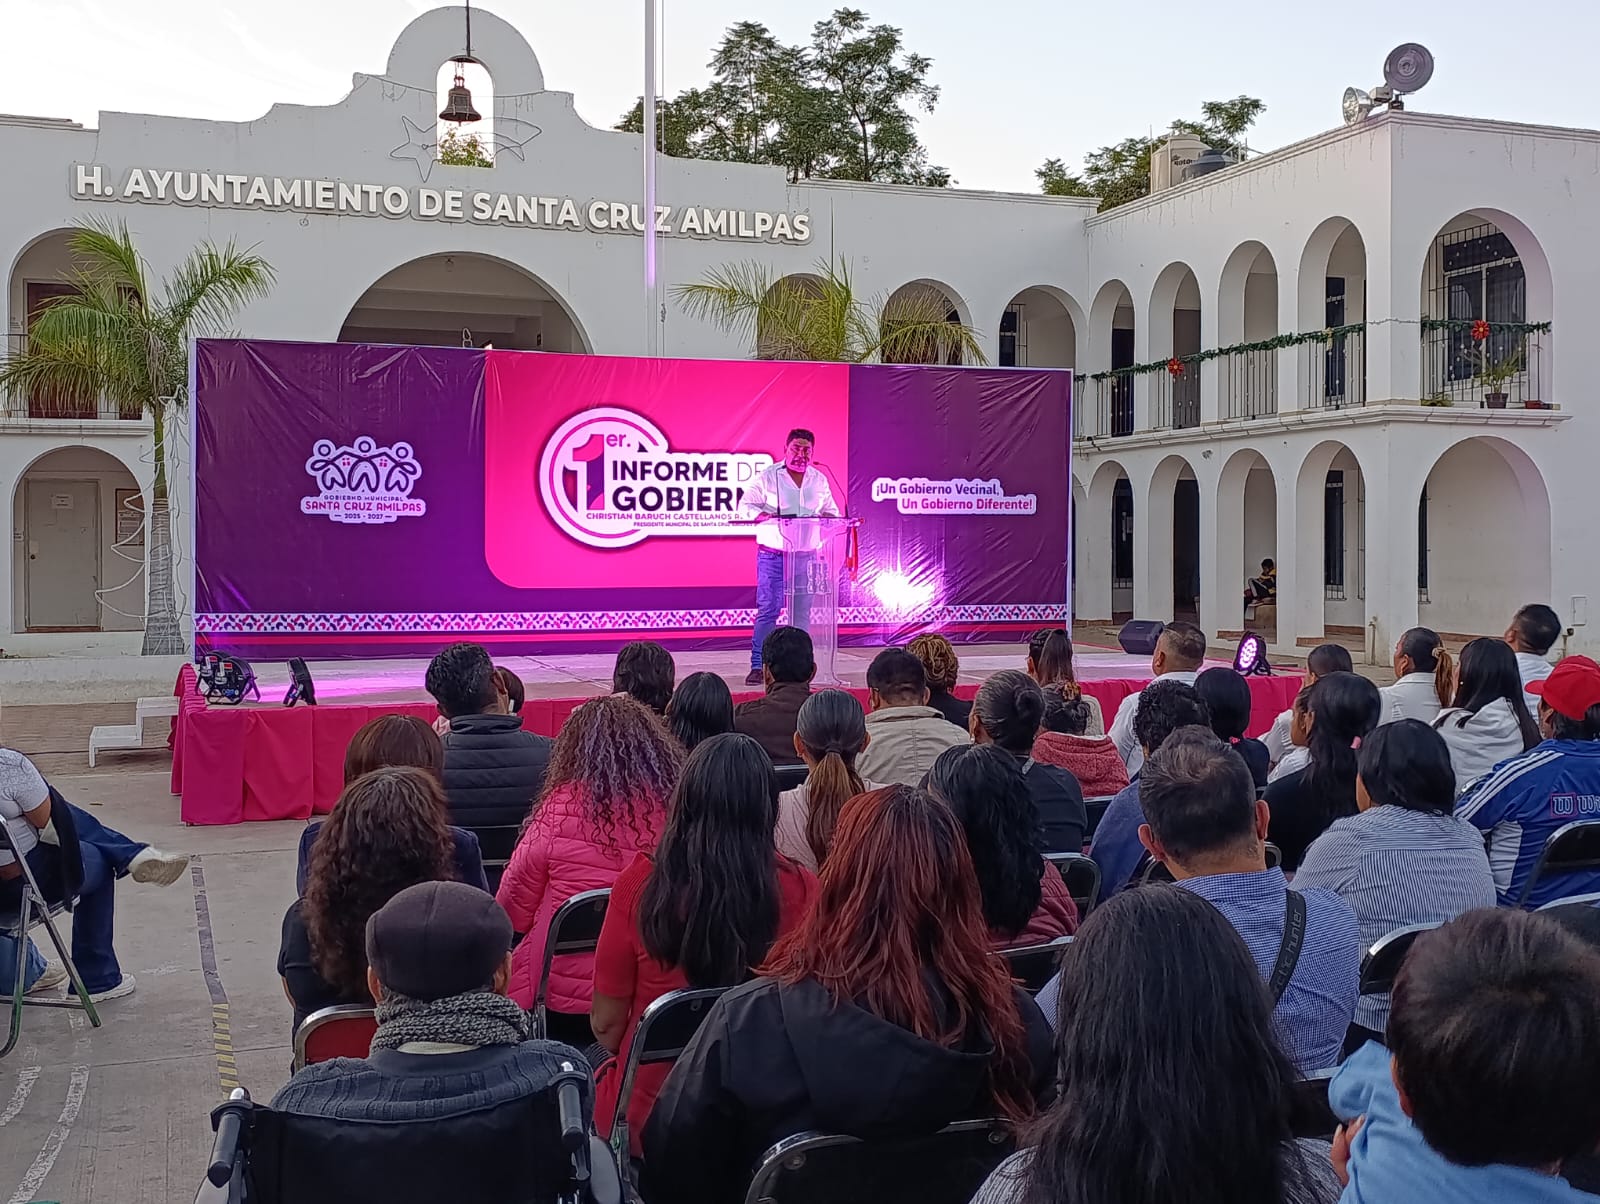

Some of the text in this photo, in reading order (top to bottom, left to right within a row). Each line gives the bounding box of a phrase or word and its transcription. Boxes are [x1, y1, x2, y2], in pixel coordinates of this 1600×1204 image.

[76, 165, 114, 196] H.
[123, 167, 409, 215] AYUNTAMIENTO
[418, 188, 464, 218] DE
[472, 191, 581, 227] SANTA
[680, 206, 811, 241] AMILPAS
[612, 460, 728, 482] INFORME
[899, 482, 951, 495] Gobierno
[955, 483, 1000, 497] Vecinal,
[305, 501, 422, 512] SANTA CRUZ AMILPAS
[902, 498, 1033, 510] Un Gobierno Diferente!
[586, 512, 633, 520] CHRISTIAN
[635, 513, 671, 521] BARUCH
[673, 513, 732, 521] CASTELLANOS
[1285, 907, 1302, 954] hunter
